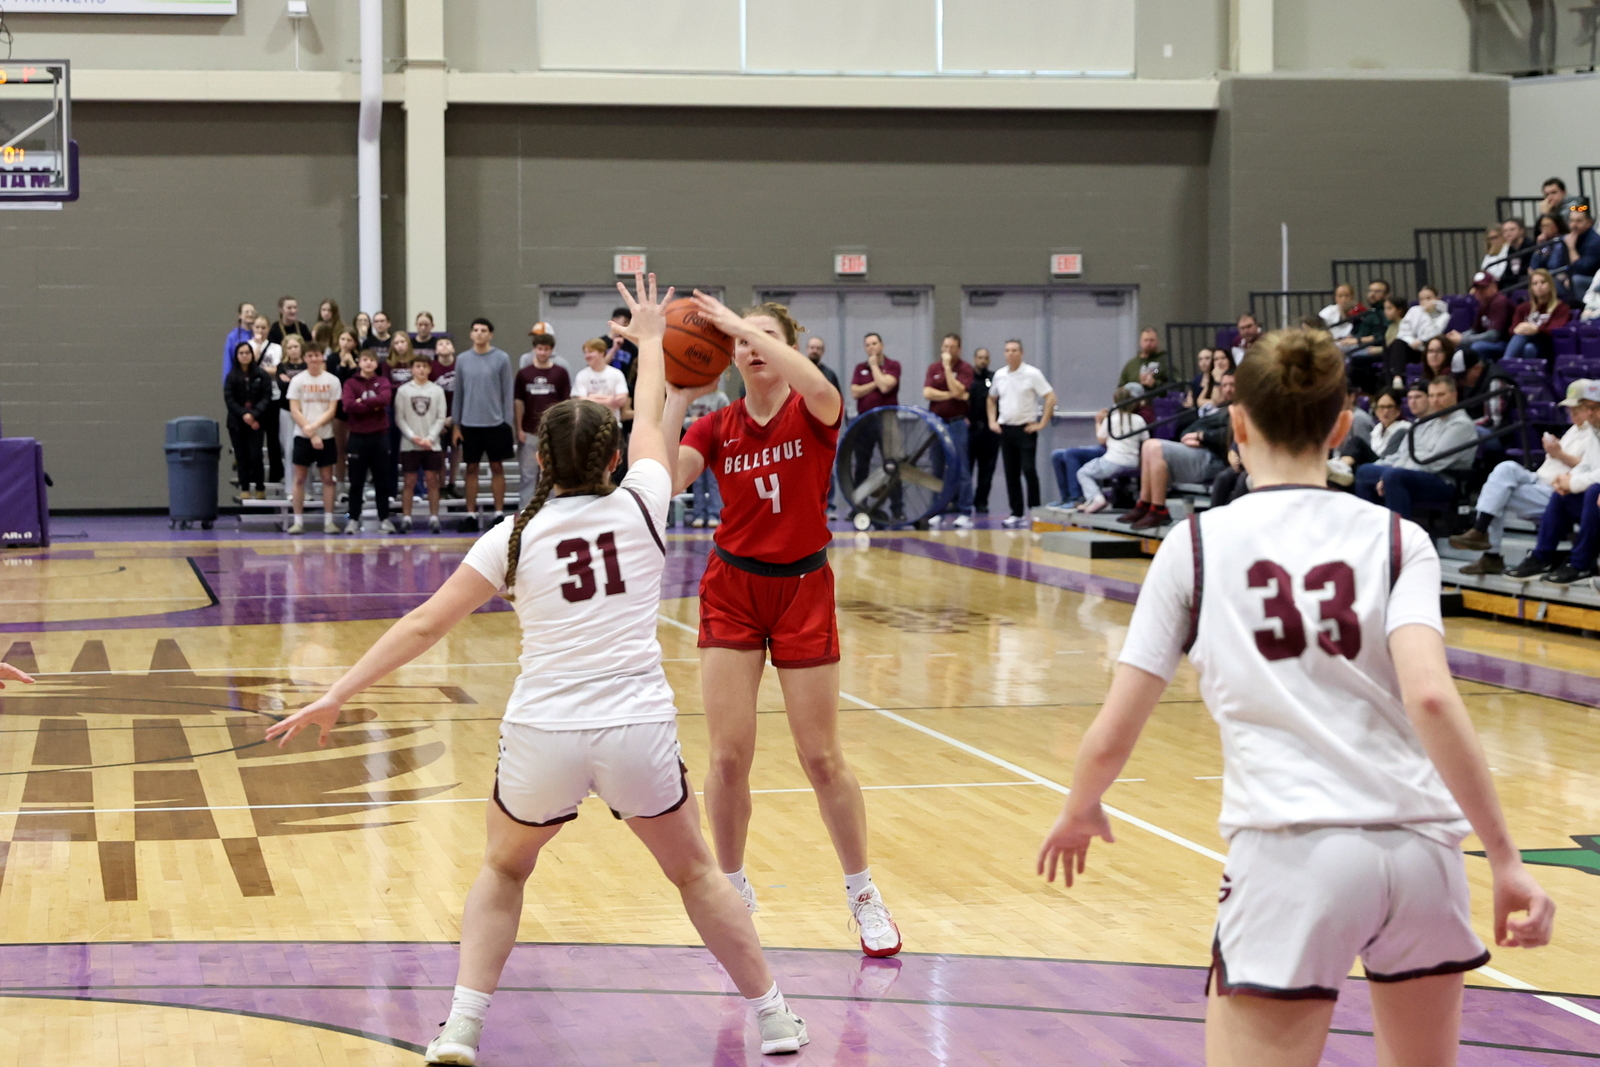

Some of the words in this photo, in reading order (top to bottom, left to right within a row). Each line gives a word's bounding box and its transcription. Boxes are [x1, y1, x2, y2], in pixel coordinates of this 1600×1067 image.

[1057, 255, 1078, 272] EXIT
[724, 438, 803, 475] BELLEVUE
[754, 472, 781, 514] 4
[555, 530, 627, 604] 31
[1245, 558, 1363, 662] 33
